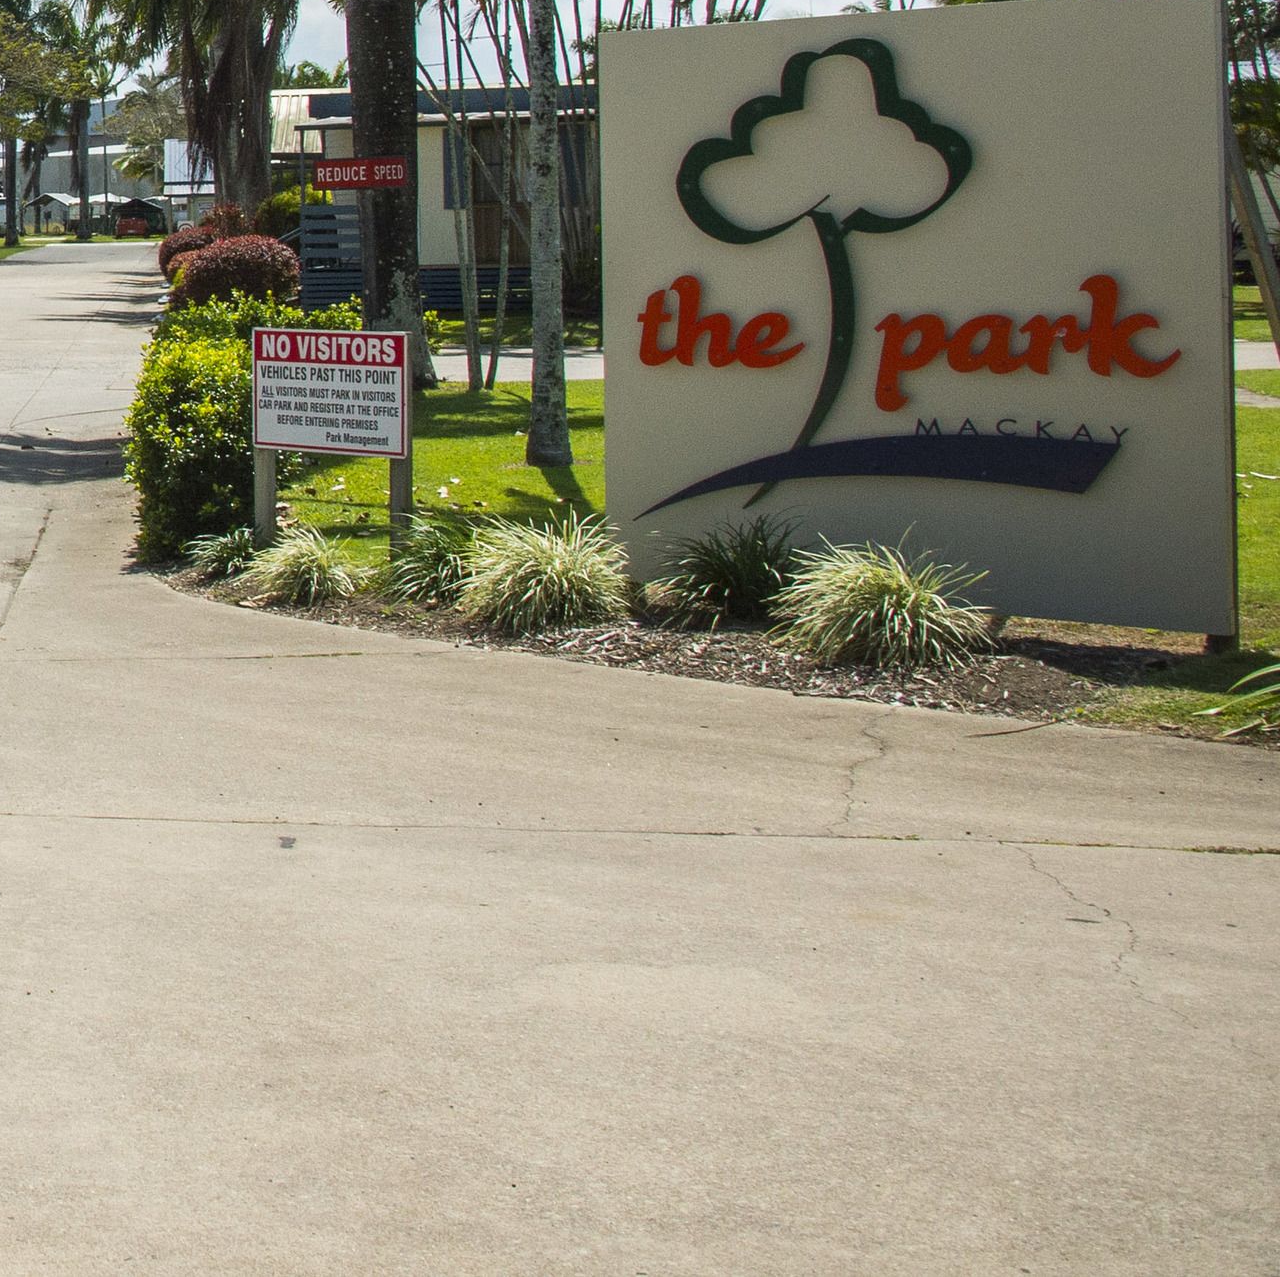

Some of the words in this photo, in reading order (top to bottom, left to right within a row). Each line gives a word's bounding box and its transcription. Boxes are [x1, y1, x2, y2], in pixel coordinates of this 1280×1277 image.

[317, 166, 367, 182] REDUCE
[374, 164, 404, 180] SPEED
[262, 334, 291, 359] NO
[296, 335, 396, 363] VISITORS
[637, 274, 806, 369] the
[874, 274, 1182, 412] park
[261, 365, 307, 381] VEHICLES
[310, 367, 336, 382] PAST
[338, 368, 362, 383] THIS
[365, 370, 397, 385] POINT
[262, 386, 274, 397] ALL
[275, 386, 307, 398] VISITORS
[309, 387, 329, 399] MUST
[331, 389, 350, 400] PARK
[352, 390, 359, 400] IN
[362, 391, 396, 403] VISITORS
[259, 399, 272, 410] CAR
[273, 400, 292, 411] PARK
[293, 402, 308, 412] AND
[310, 402, 344, 414] REGISTER
[346, 404, 355, 415] AT
[358, 405, 371, 416] THE
[373, 406, 399, 417] OFFICE
[277, 414, 304, 426] BEFORE
[305, 416, 339, 428] ENTERING
[342, 419, 378, 431] PREMISES
[326, 432, 342, 443] Park
[343, 433, 389, 446] Management
[915, 418, 1129, 446] MACKAY
